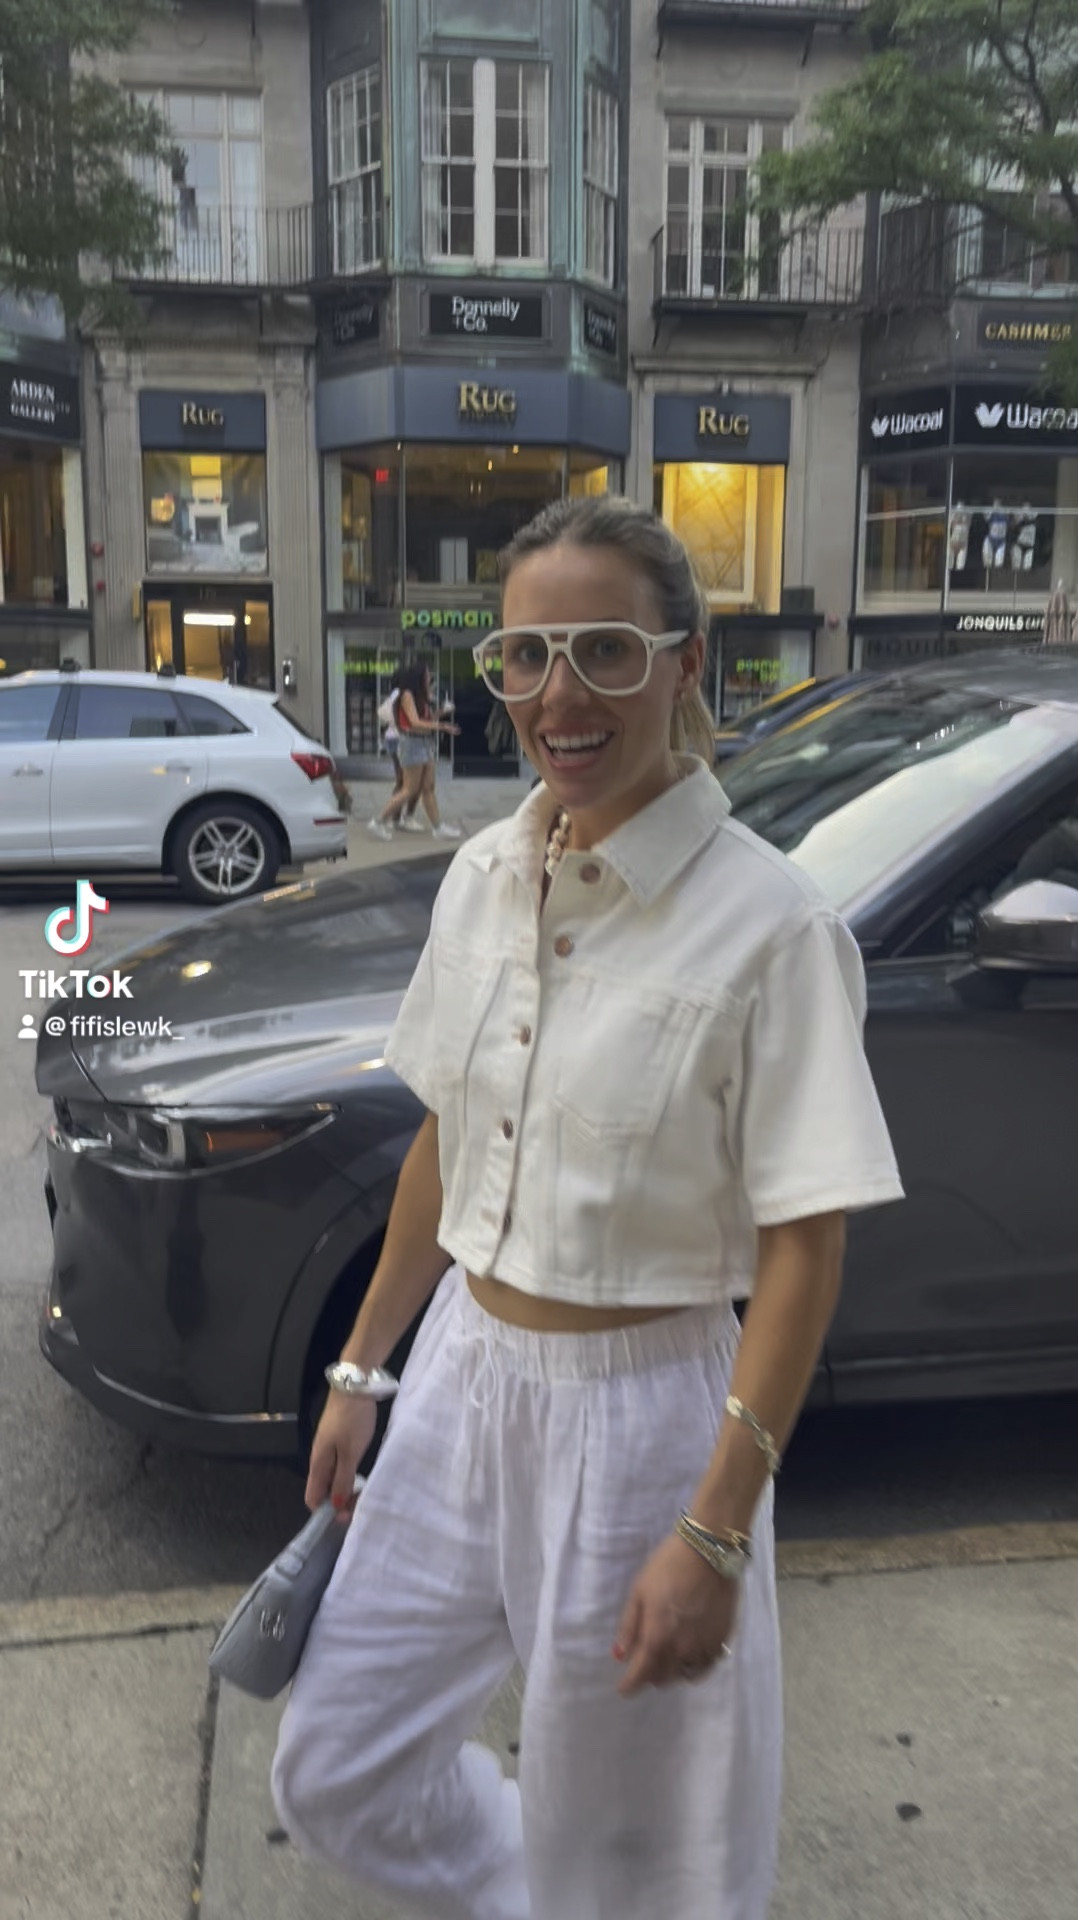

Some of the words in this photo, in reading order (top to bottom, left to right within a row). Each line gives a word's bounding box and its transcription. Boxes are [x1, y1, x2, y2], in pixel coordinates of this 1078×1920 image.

[452, 296, 520, 321] Donnelly
[985, 323, 1073, 340] CASHMER
[11, 378, 55, 404] ARDEN
[11, 402, 55, 424] GALLERY
[890, 408, 944, 435] Wacoal
[1006, 403, 1078, 429] Wacoa
[402, 610, 493, 630] posman
[956, 616, 1024, 631] JONQUILS
